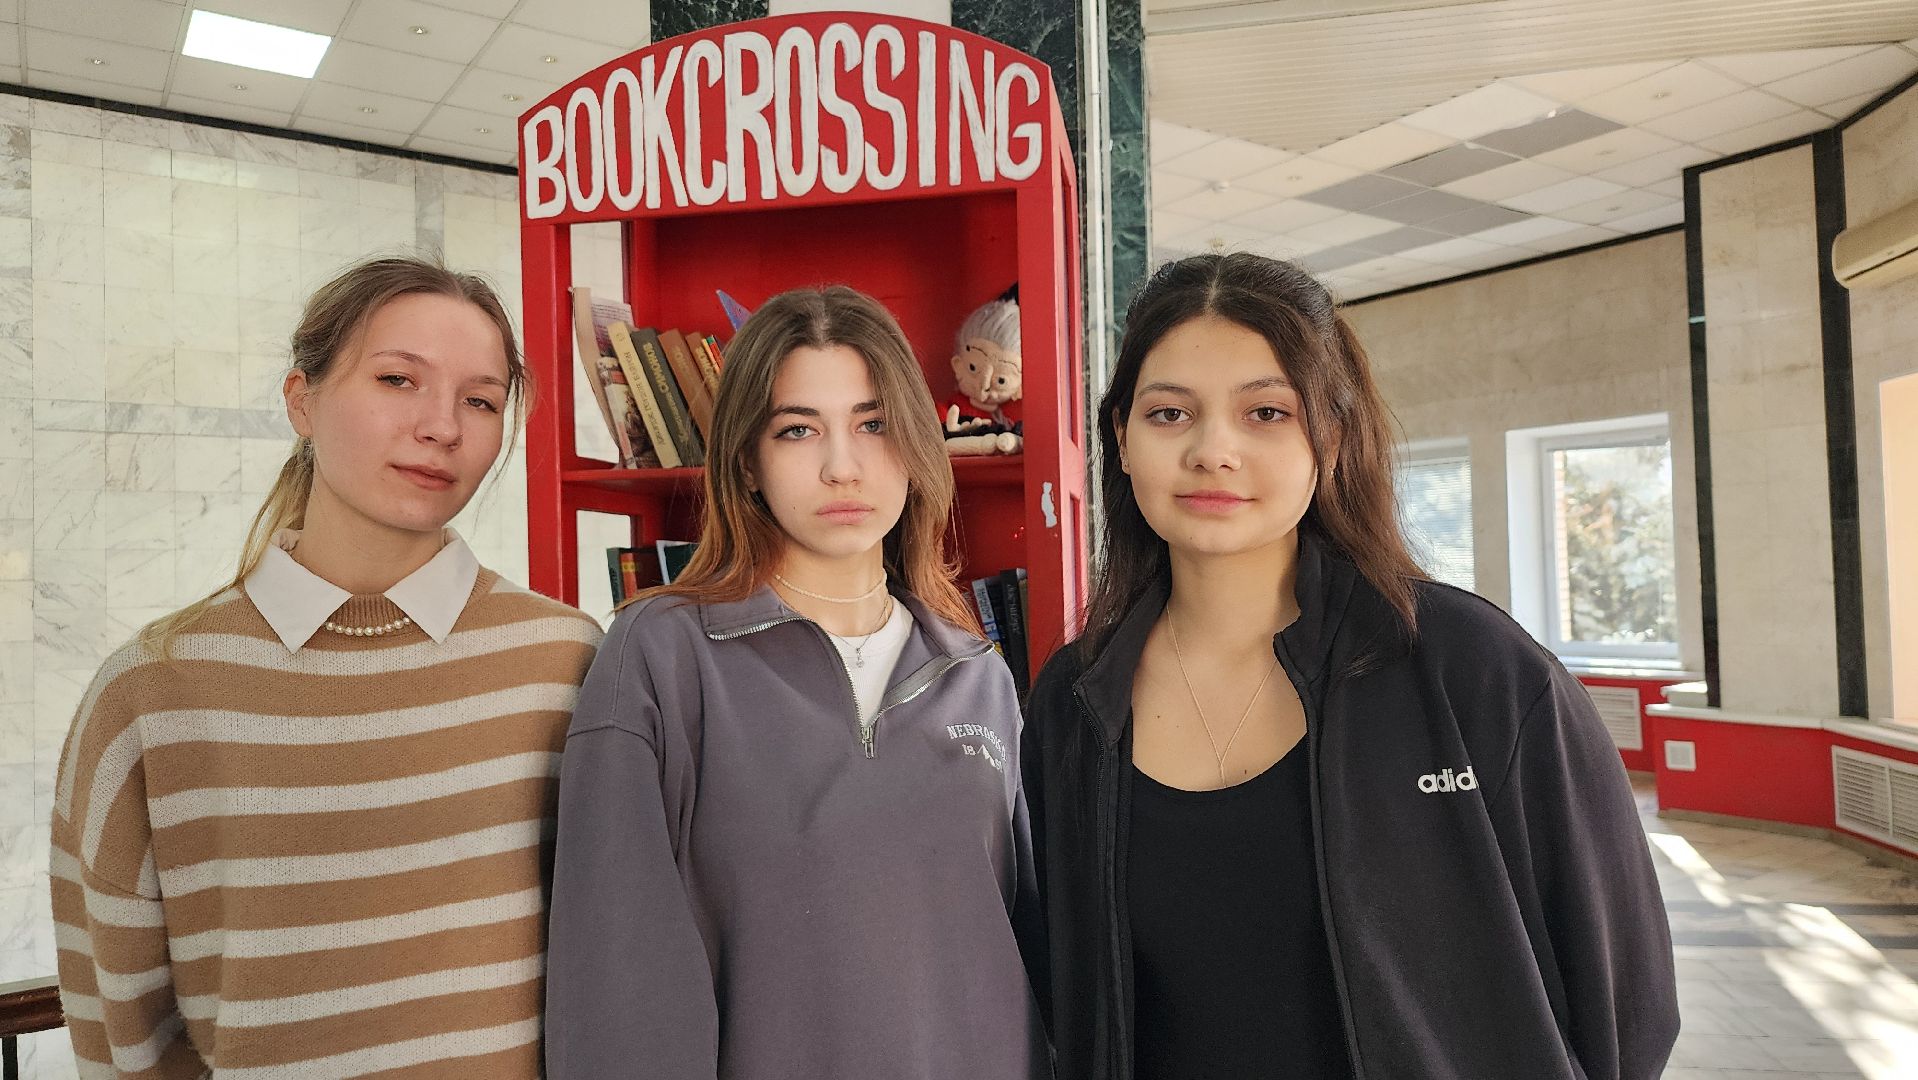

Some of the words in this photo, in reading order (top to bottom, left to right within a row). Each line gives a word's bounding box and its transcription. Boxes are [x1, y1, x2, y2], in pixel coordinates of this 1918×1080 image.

[522, 22, 1043, 220] BOOKCROSSING
[946, 723, 1007, 762] NEBRASKA
[962, 744, 976, 756] 18
[1417, 765, 1480, 794] adid
